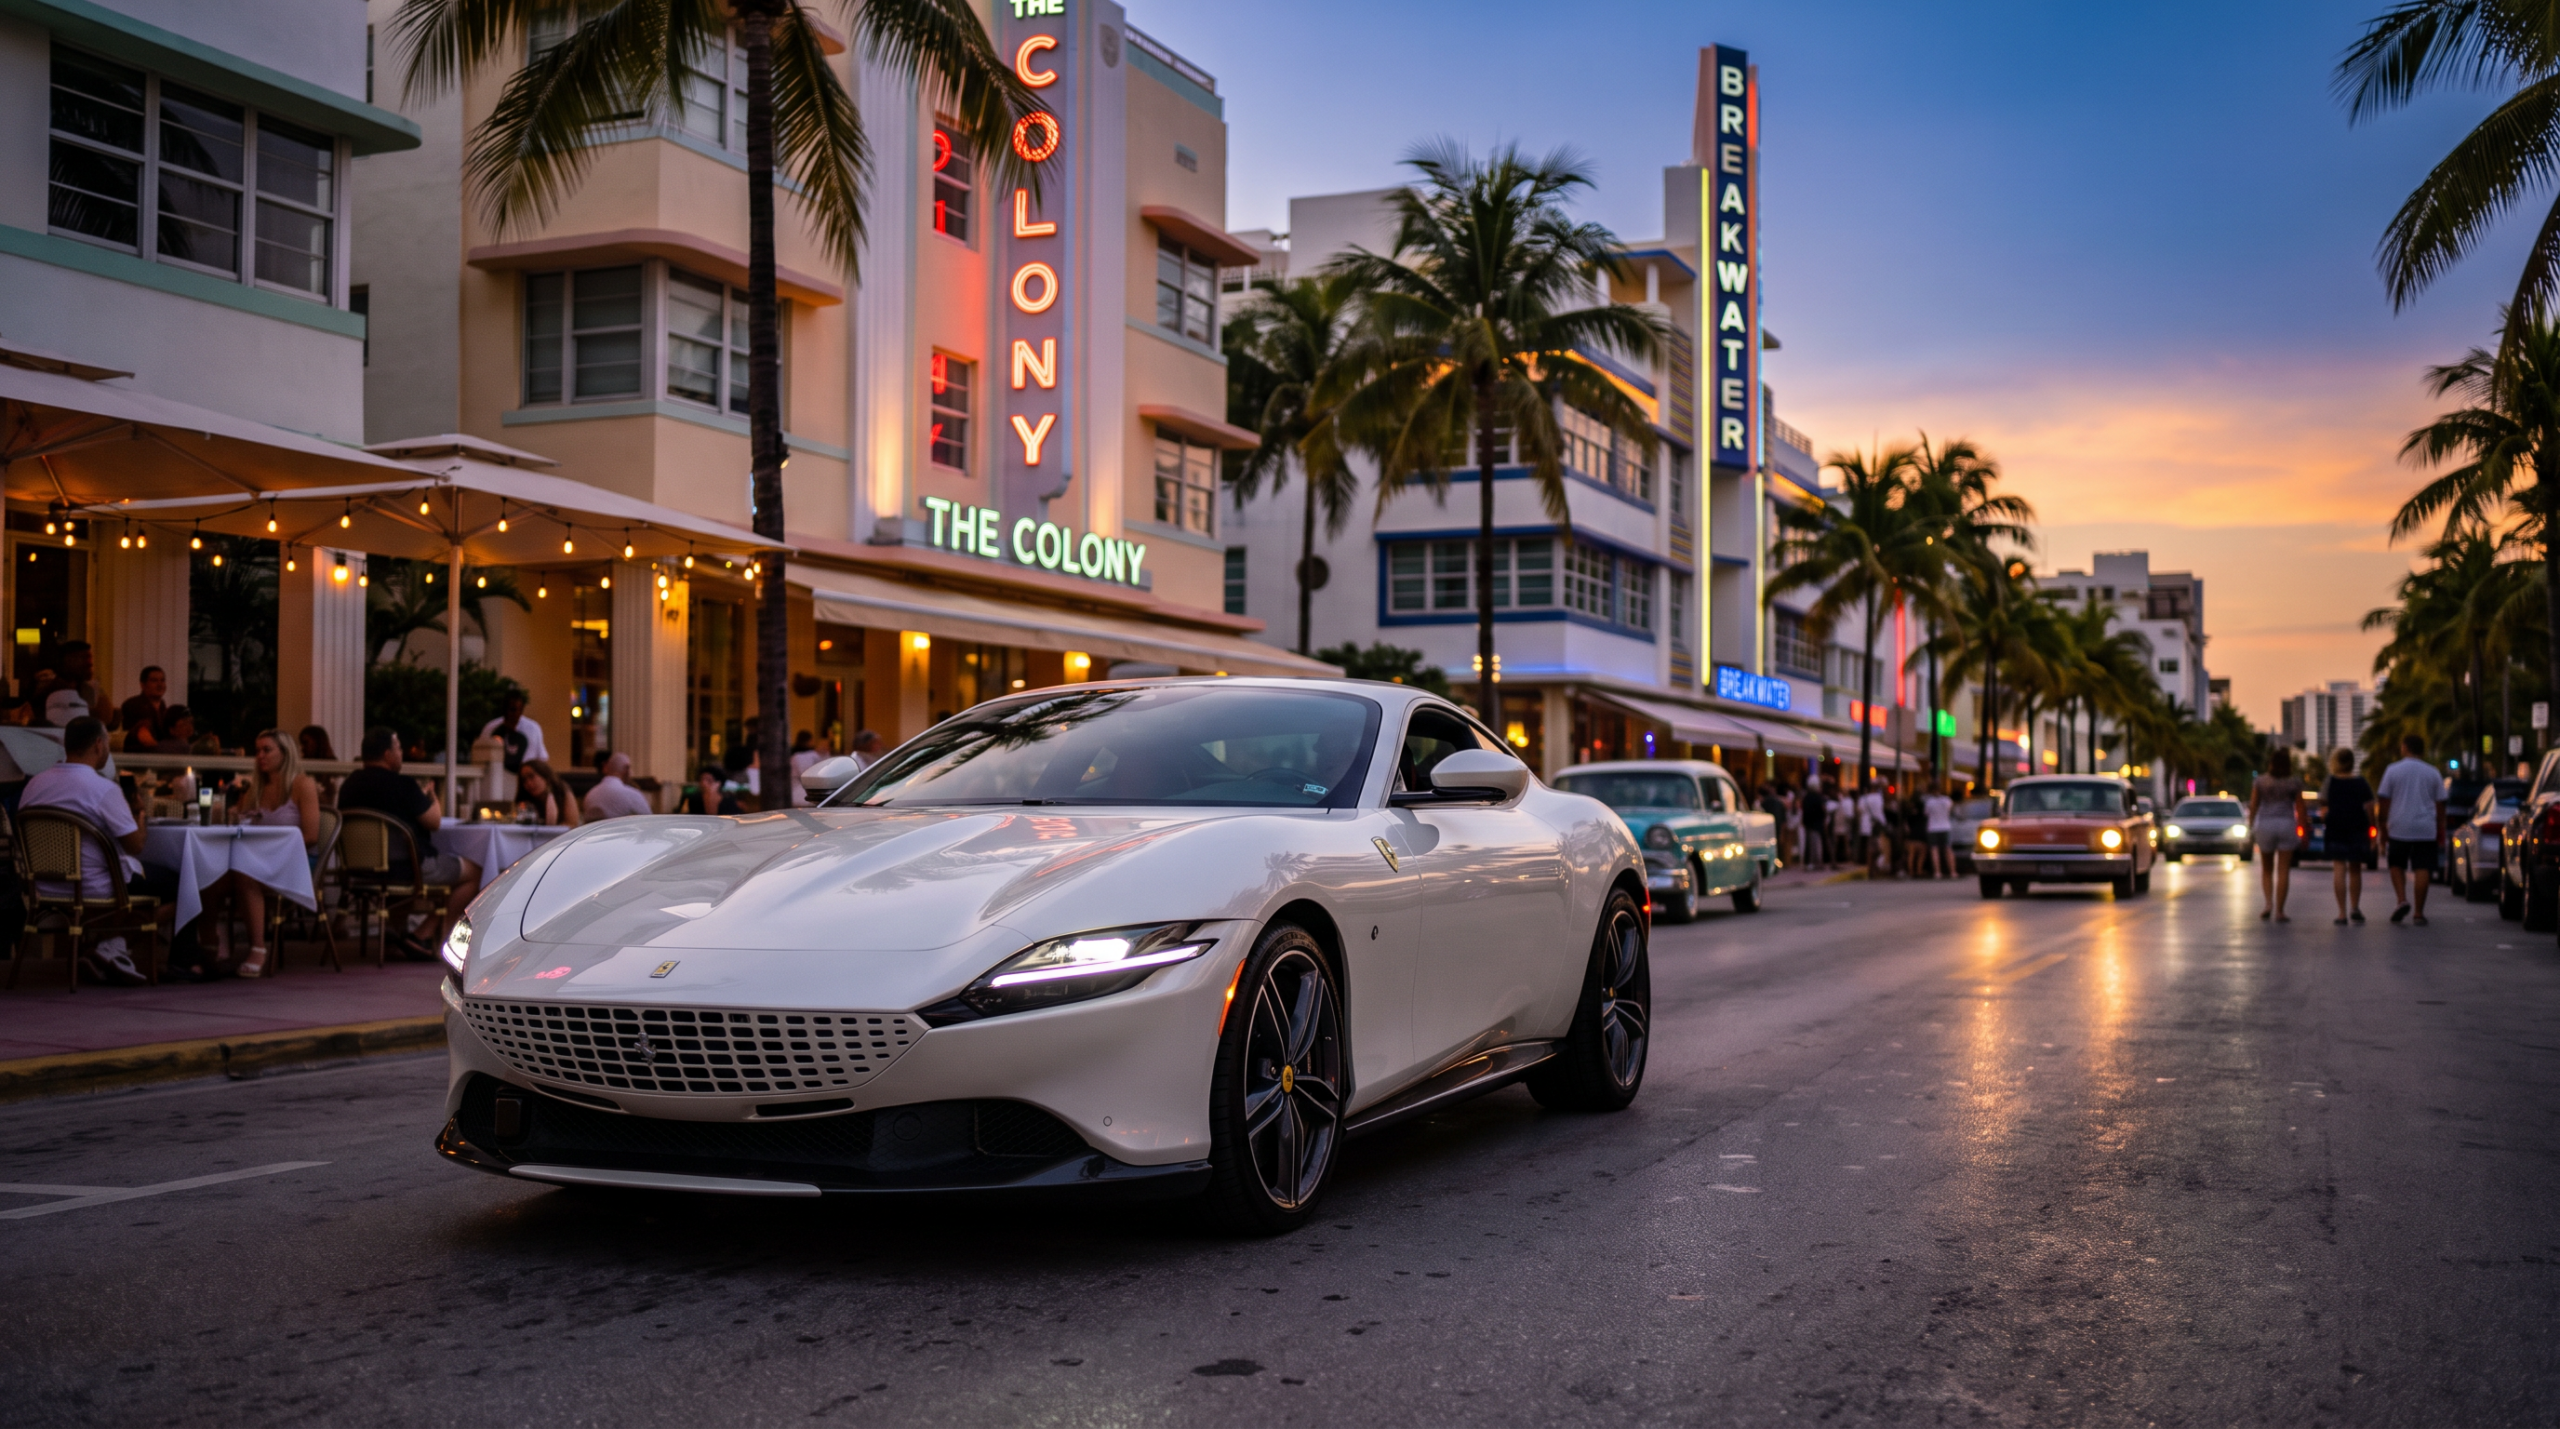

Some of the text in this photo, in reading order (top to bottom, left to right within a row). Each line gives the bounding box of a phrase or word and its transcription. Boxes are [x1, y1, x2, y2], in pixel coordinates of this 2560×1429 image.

[1011, 33, 1060, 466] COLONY
[1717, 65, 1748, 450] BREAKWATER
[926, 496, 1146, 585] THE COLONY
